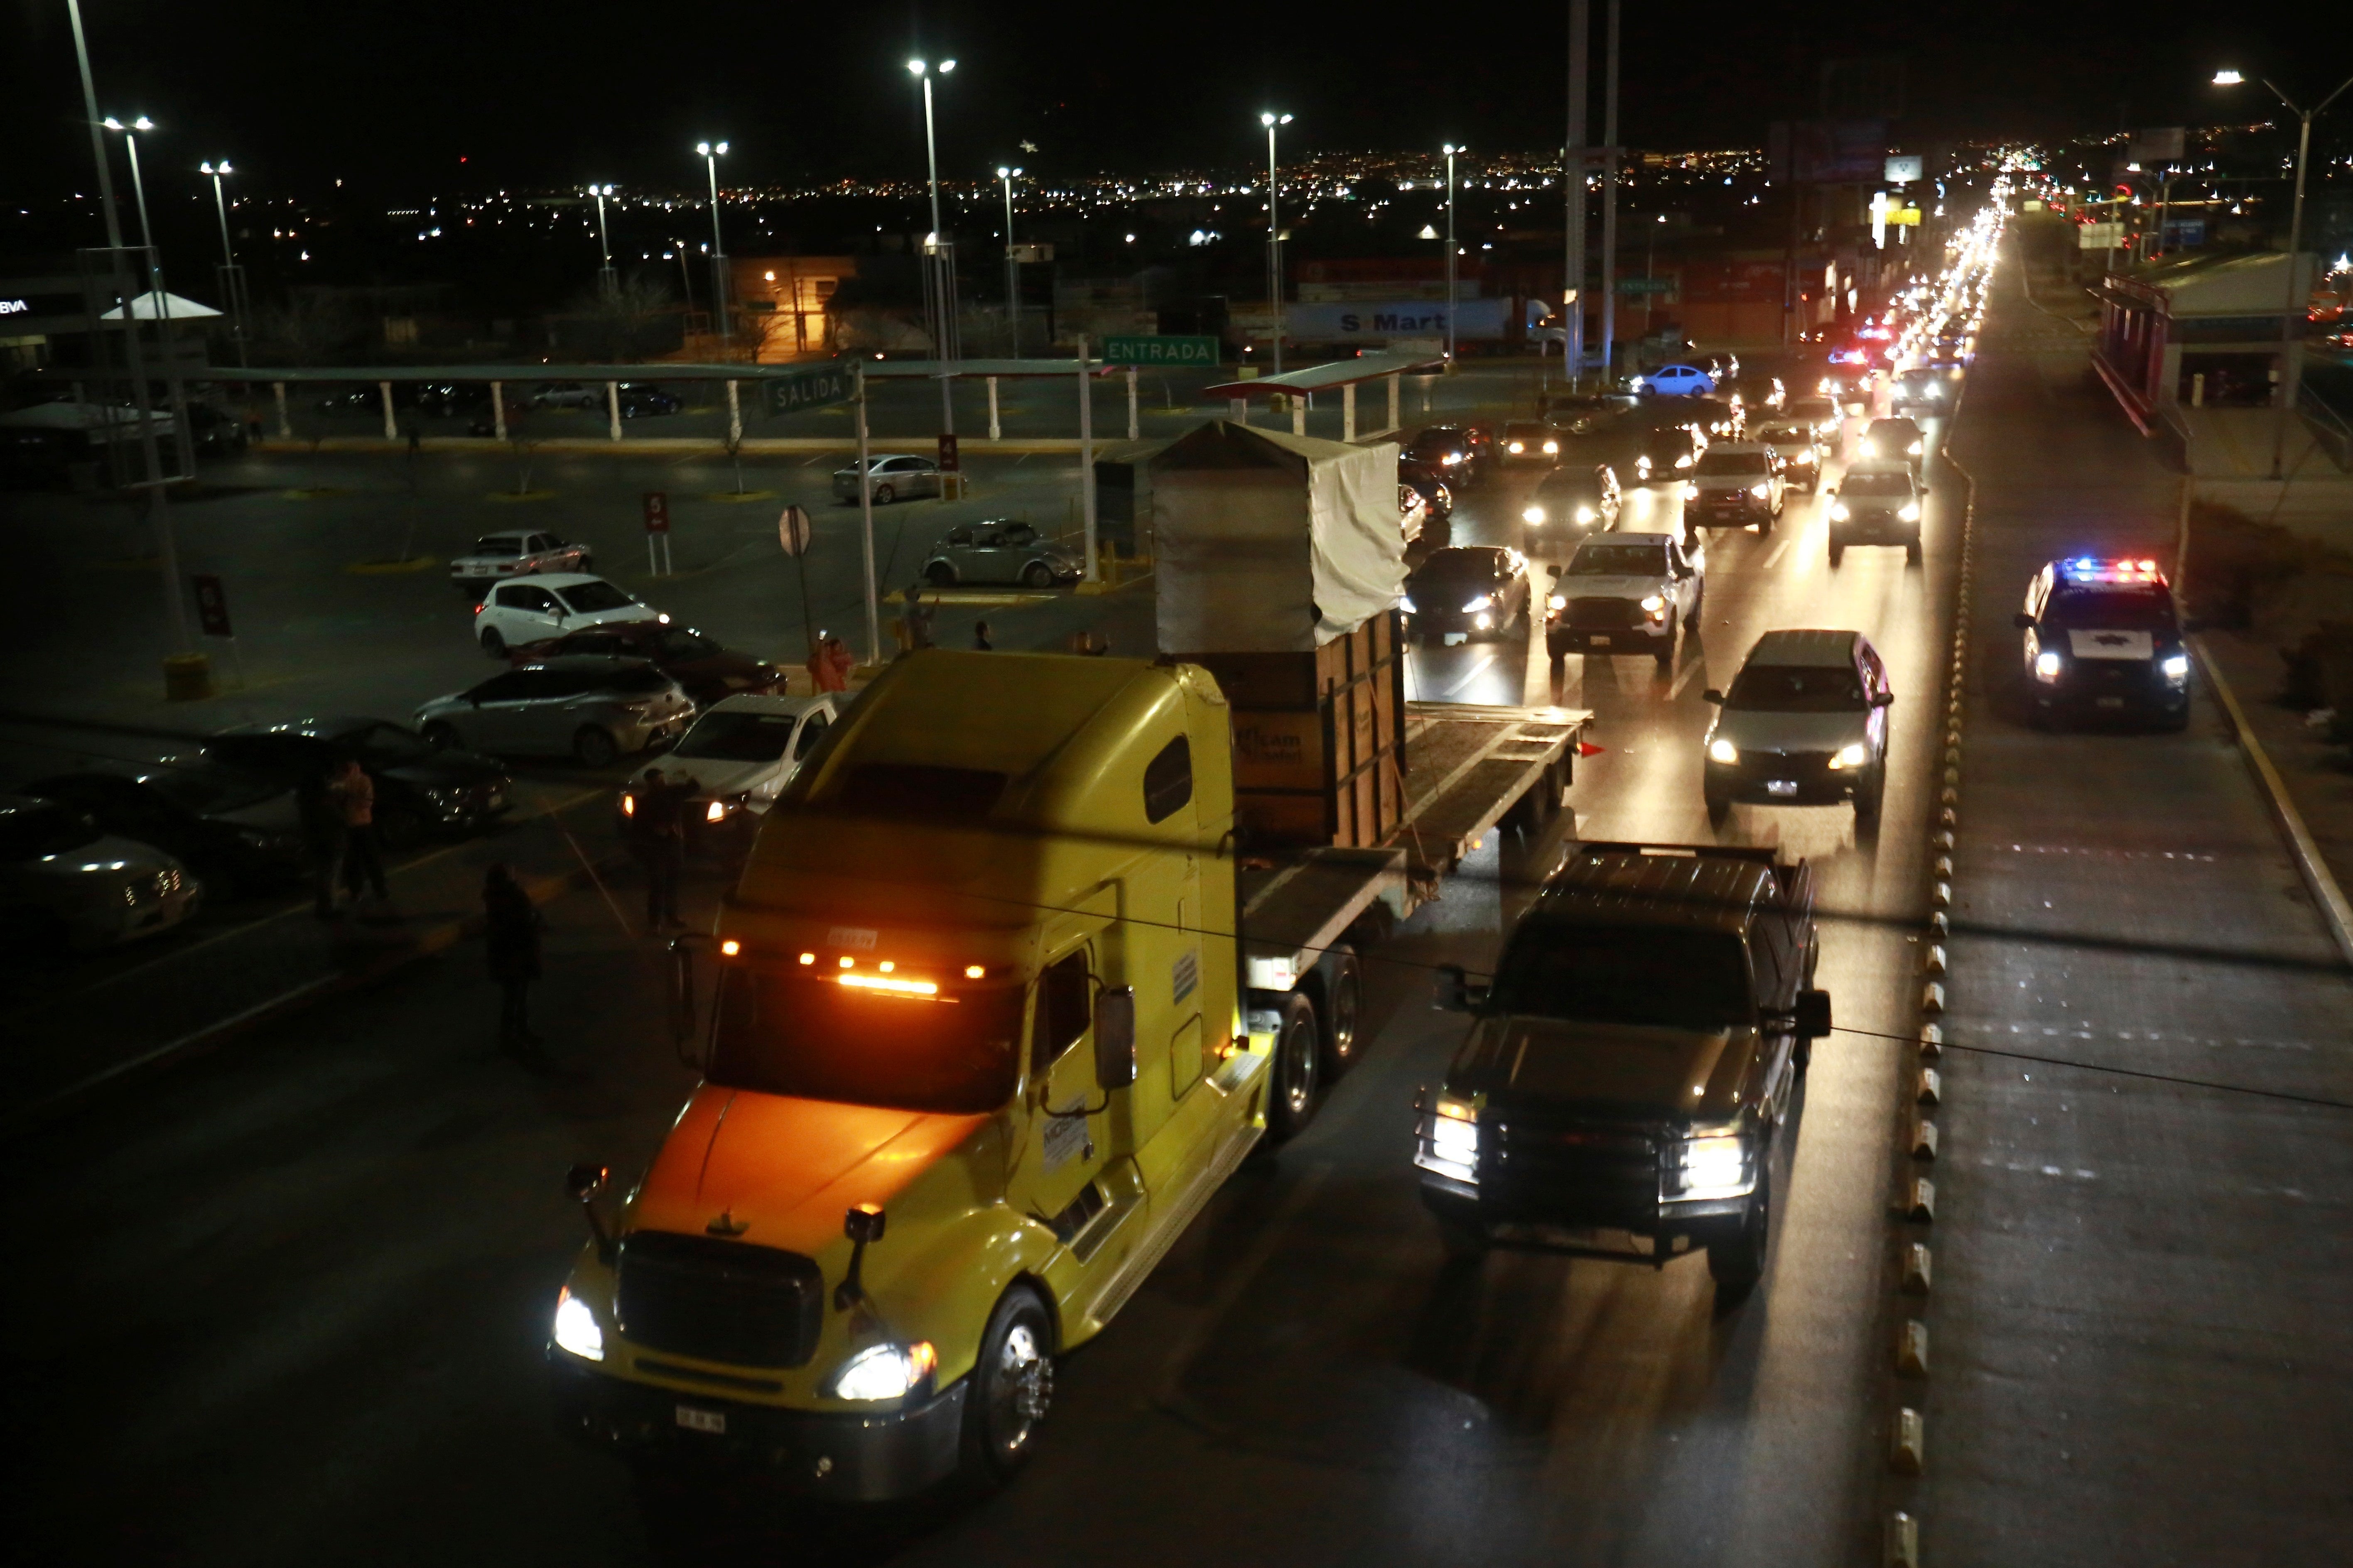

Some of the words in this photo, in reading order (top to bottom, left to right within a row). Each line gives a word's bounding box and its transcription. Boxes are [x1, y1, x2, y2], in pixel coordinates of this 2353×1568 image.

[1340, 314, 1360, 333] S
[1373, 313, 1447, 332] Mart
[1109, 342, 1210, 360] ENTRADA
[776, 376, 841, 408] SALIDA
